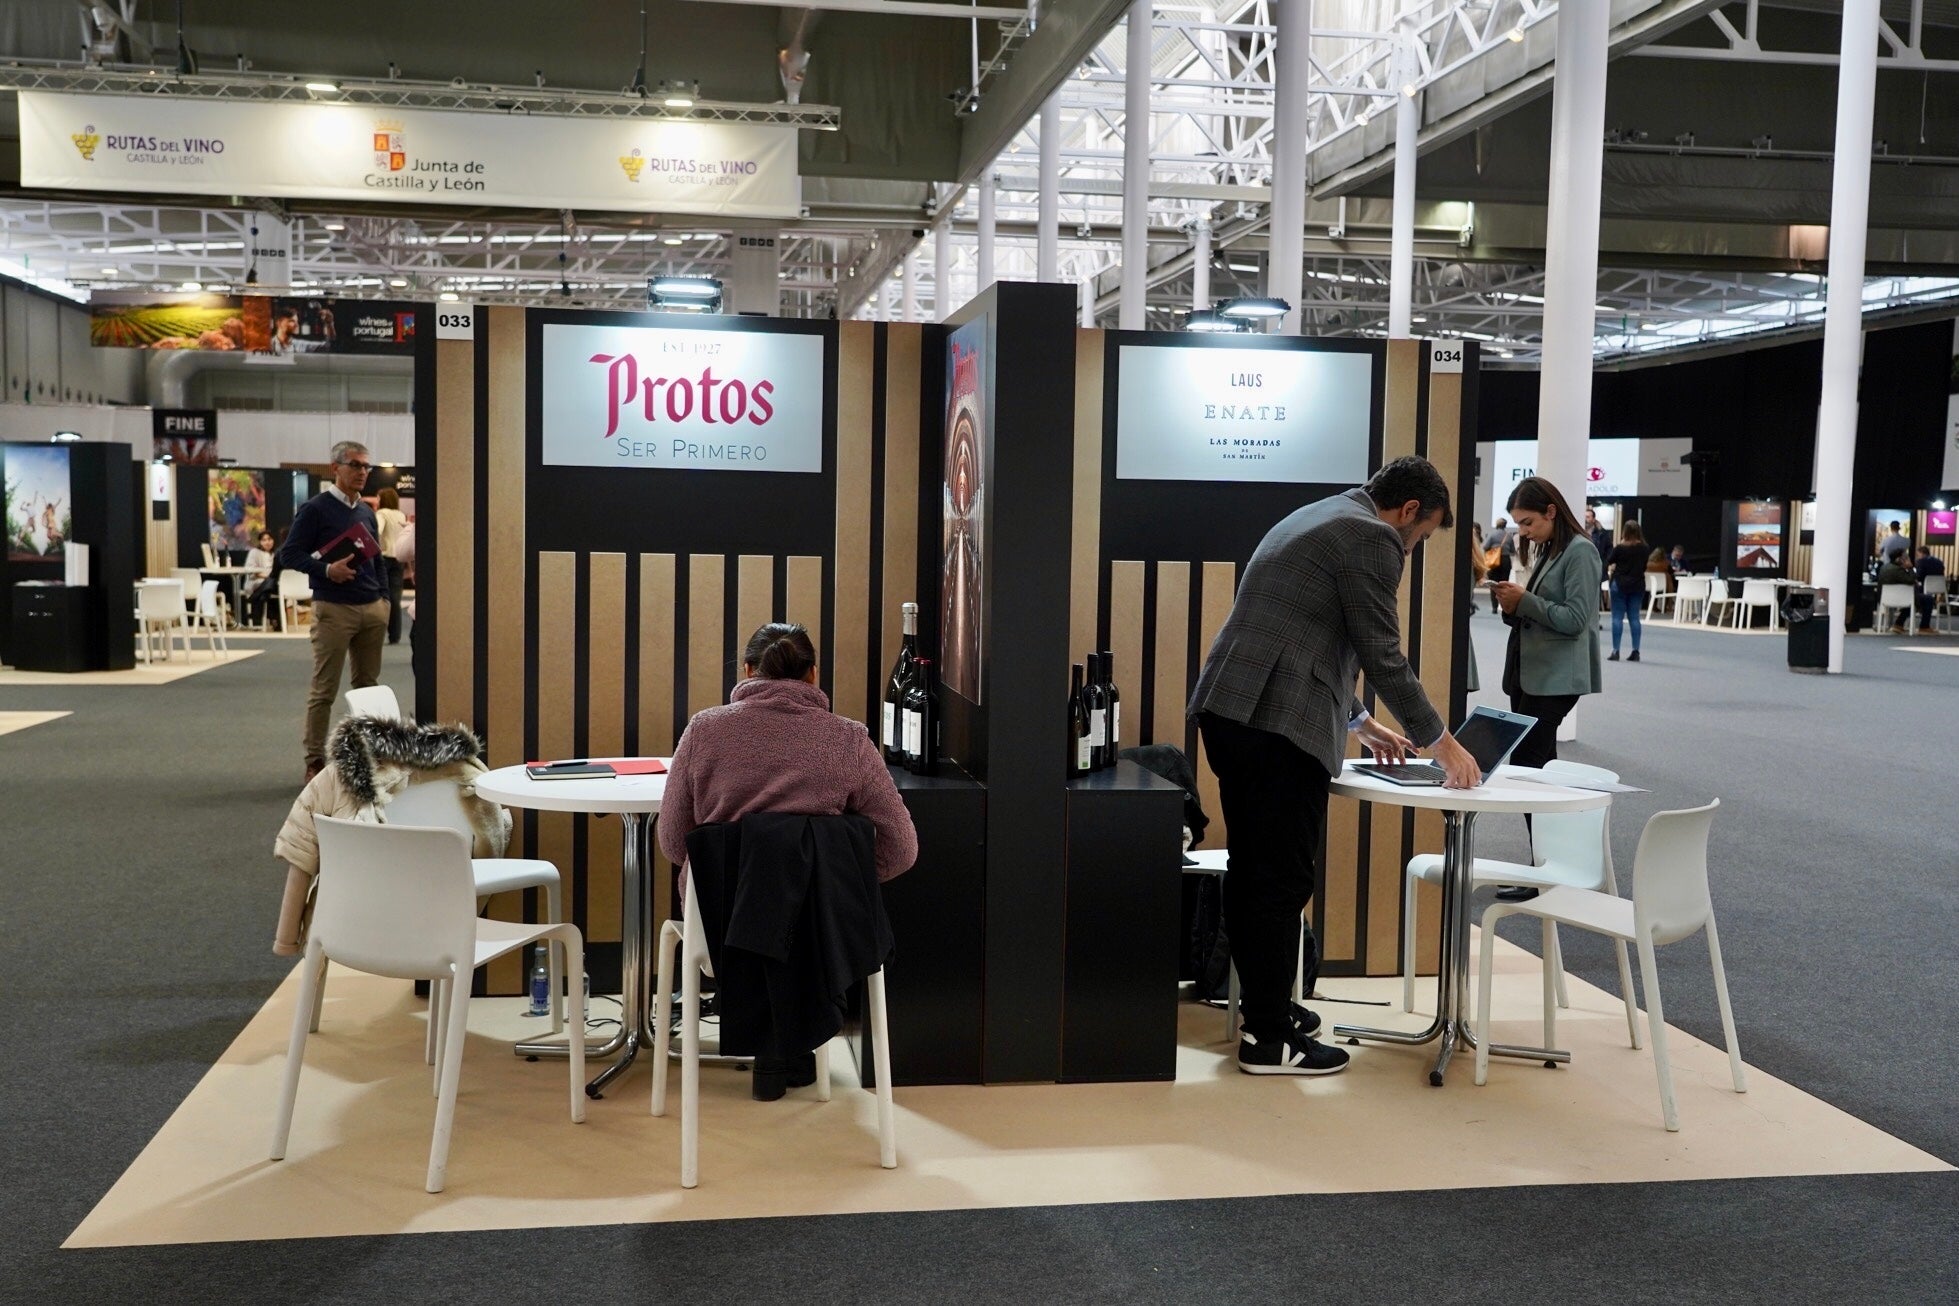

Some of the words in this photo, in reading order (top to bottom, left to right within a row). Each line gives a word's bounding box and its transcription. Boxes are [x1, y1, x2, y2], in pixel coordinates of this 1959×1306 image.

[107, 135, 157, 151] RUTAS
[160, 141, 180, 152] DEL
[183, 138, 225, 154] VINO
[126, 153, 168, 163] CASTILLA
[179, 153, 204, 165] LEÓN
[411, 159, 459, 173] Junta
[463, 161, 485, 174] de
[651, 158, 696, 173] RUTAS
[700, 163, 717, 174] DEL
[721, 161, 758, 175] VINO
[364, 174, 424, 188] Castilla
[428, 179, 439, 192] y
[444, 177, 485, 191] León
[668, 175, 707, 185] CASTILLA
[716, 175, 739, 186] LEÓN
[359, 316, 387, 326] wines
[439, 314, 471, 328] 033
[353, 327, 394, 338] portugal
[1434, 350, 1461, 362] 034
[1231, 373, 1263, 387] LAUS
[588, 353, 775, 439] Protos
[1204, 404, 1286, 421] ENATE
[165, 416, 206, 431] FINE
[617, 437, 657, 458] SER
[672, 439, 768, 461] PRIMERO
[1209, 438, 1228, 446] LAS
[1233, 439, 1281, 447] MORADAS
